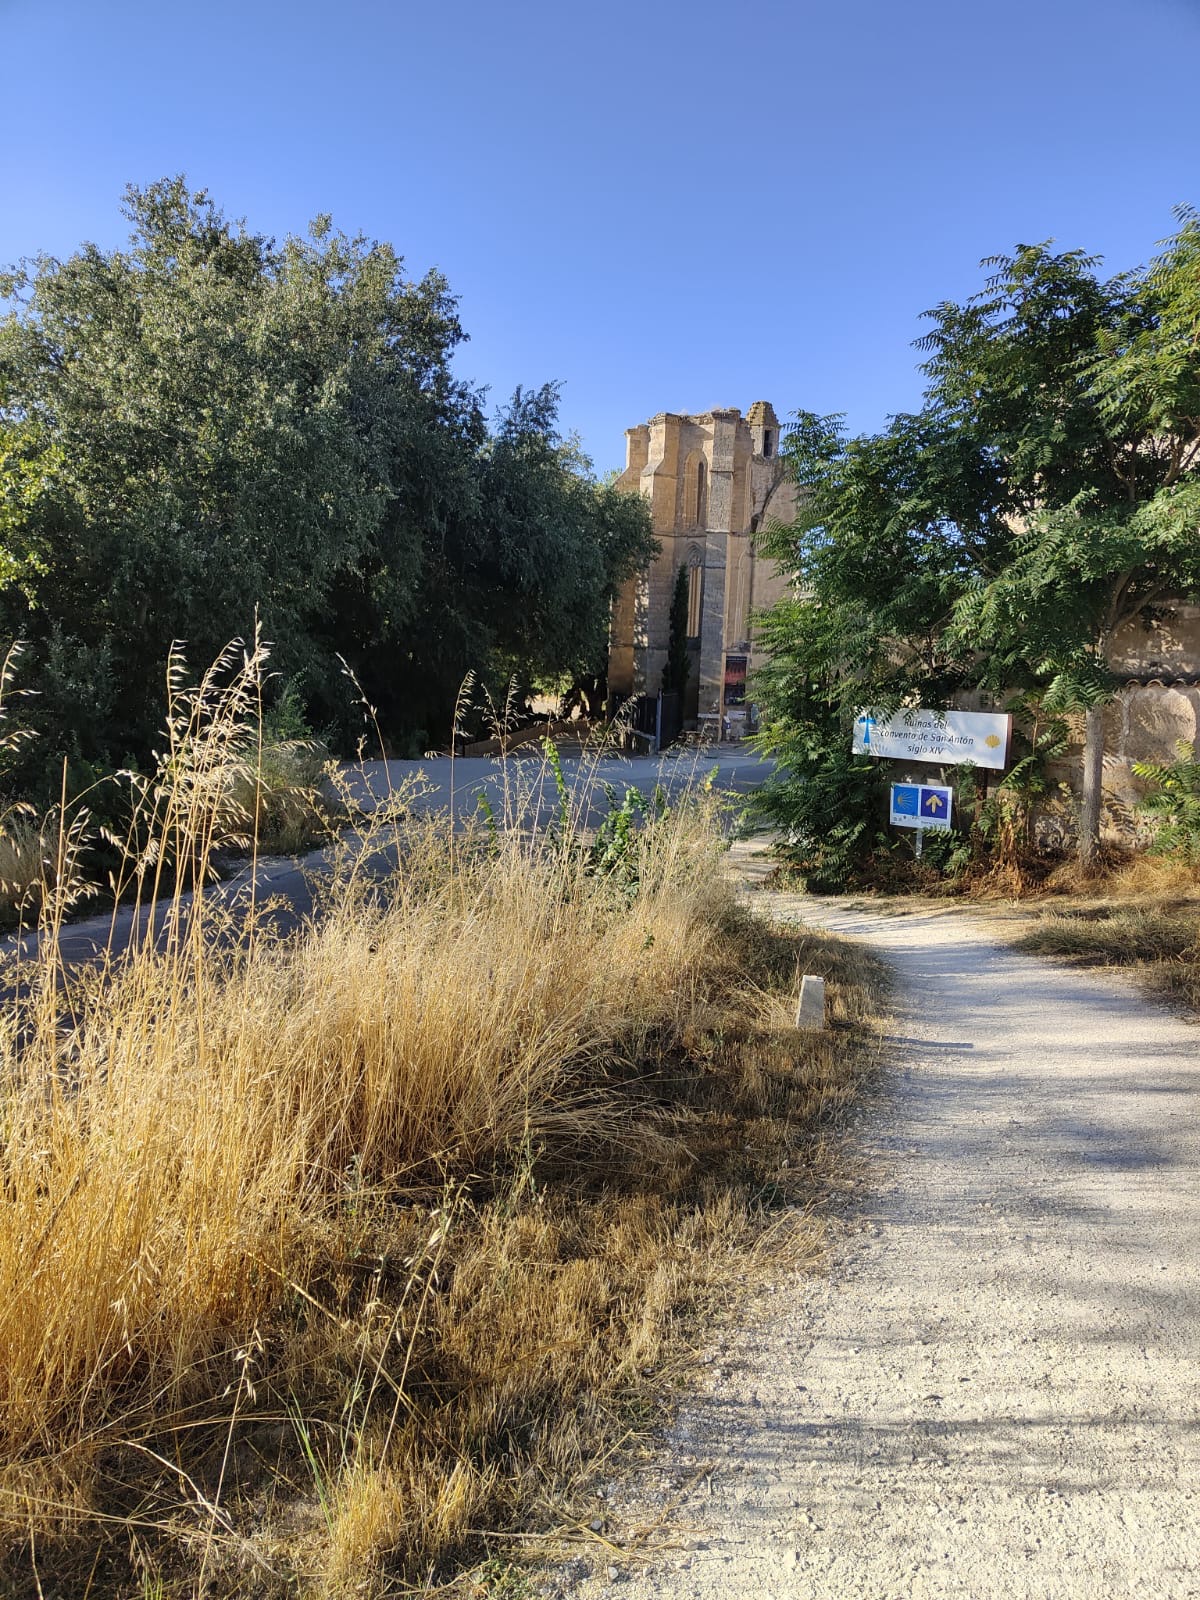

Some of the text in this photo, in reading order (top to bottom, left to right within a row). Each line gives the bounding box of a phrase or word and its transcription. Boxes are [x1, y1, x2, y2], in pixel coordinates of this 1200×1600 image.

[904, 718, 948, 730] Ruinas del
[918, 732, 928, 741] de
[930, 733, 946, 742] San
[947, 735, 974, 745] Antón
[907, 744, 944, 754] siglo XIV
